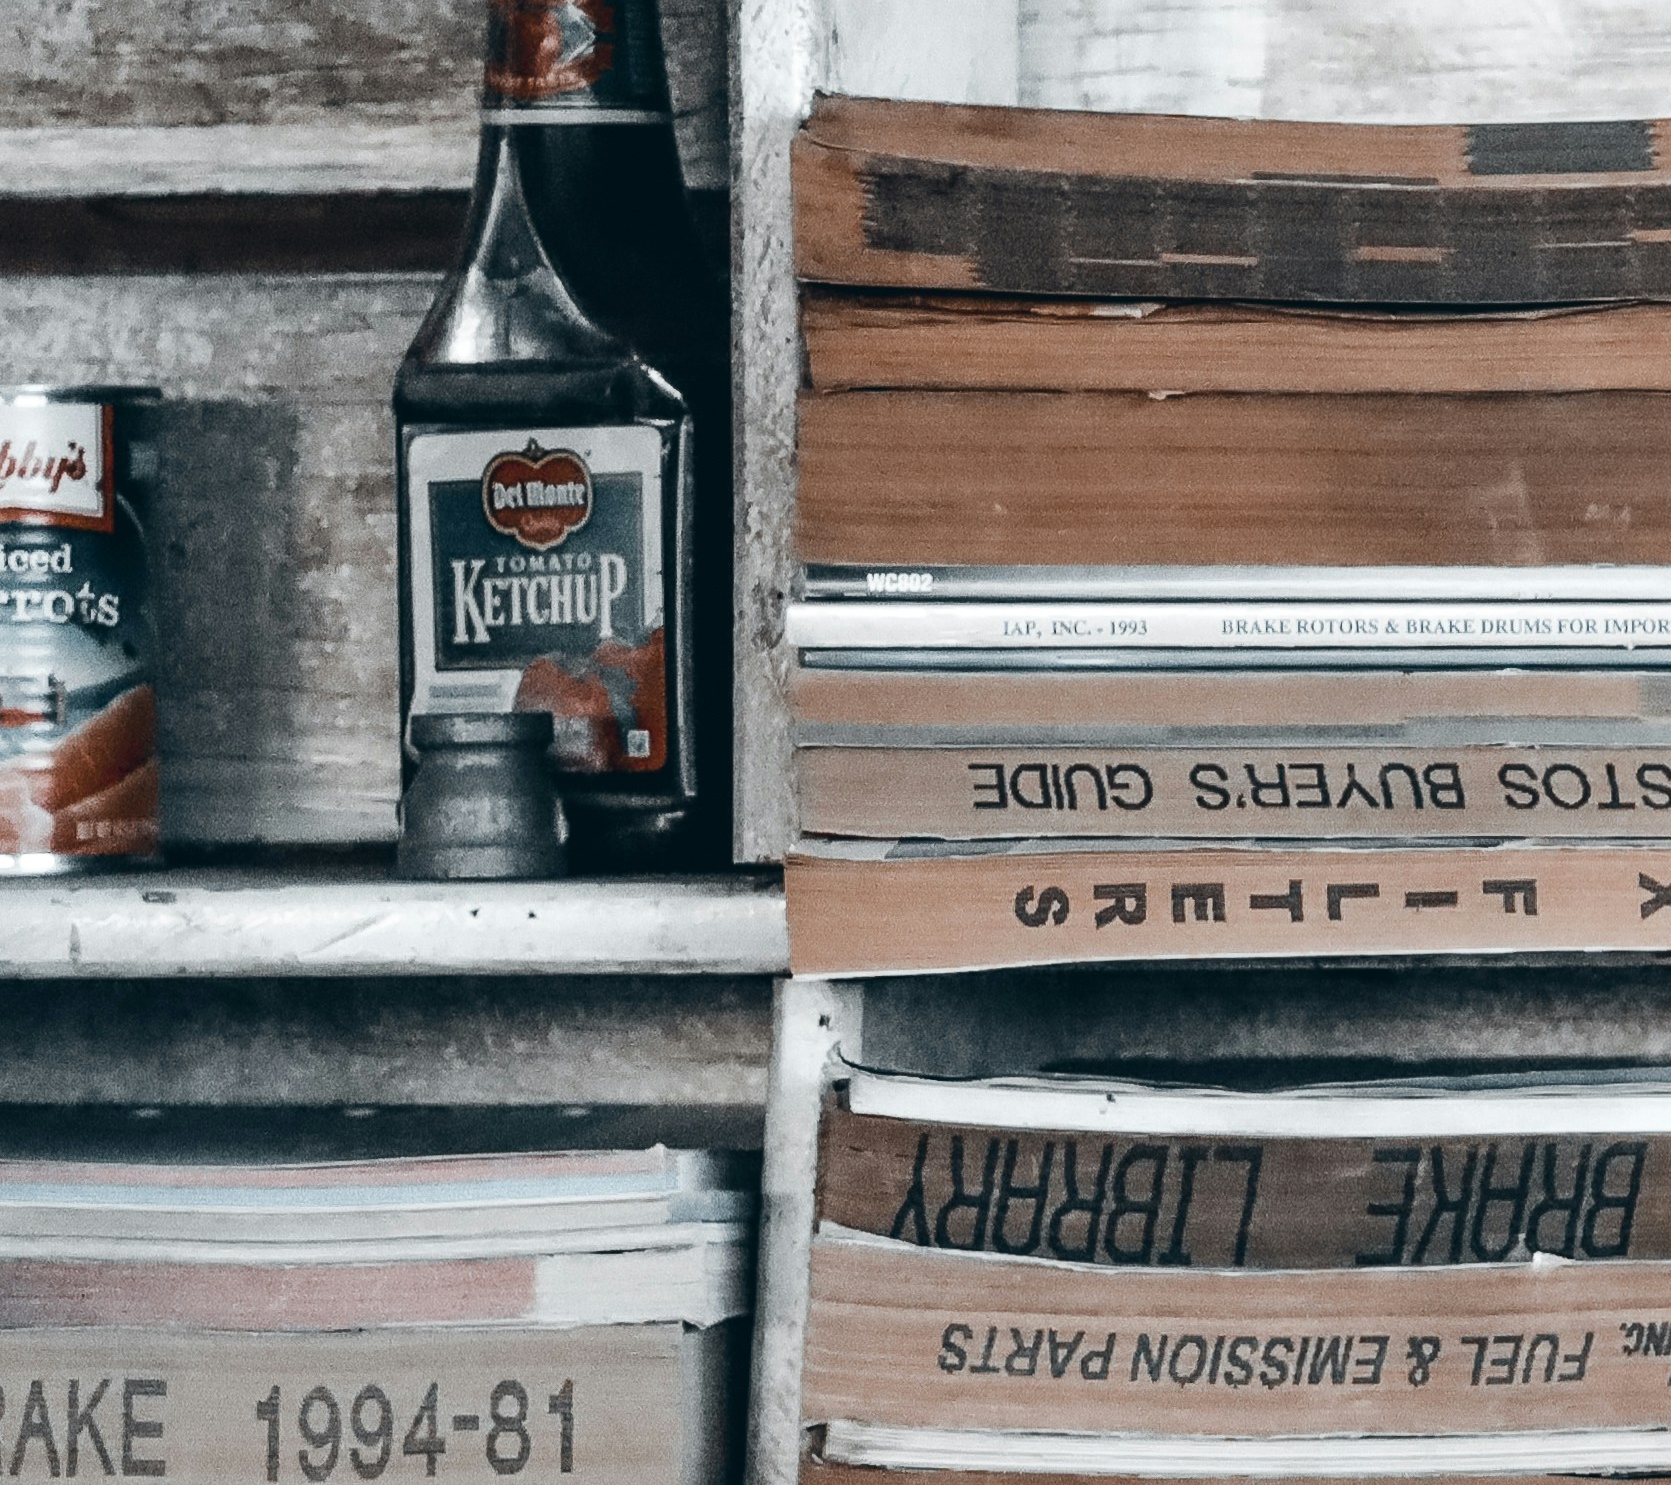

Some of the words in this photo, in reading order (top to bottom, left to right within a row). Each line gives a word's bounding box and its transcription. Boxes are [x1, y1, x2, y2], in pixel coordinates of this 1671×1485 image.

[492, 481, 523, 509] Del
[526, 480, 586, 507] Monte
[497, 554, 593, 573] TOMATO
[450, 552, 629, 645] KETCHUP
[1219, 619, 1289, 637] BRAKE
[1294, 618, 1377, 637] ROTORS
[1383, 619, 1400, 637] &
[1404, 618, 1472, 636] BRAKE
[1479, 618, 1551, 636] DRUMS
[1556, 618, 1599, 636] FOR
[966, 762, 1155, 812] GUIDE
[1188, 761, 1467, 812] BUYER'S
[1013, 875, 1539, 930] FILTERS
[887, 1131, 1265, 1261] LIBRARY
[1356, 1141, 1647, 1265] BRAKE
[936, 1321, 1119, 1383] PARTS
[1129, 1332, 1392, 1391] EMISSION
[1404, 1333, 1444, 1390] &
[1458, 1330, 1597, 1388] FUEL
[0, 1376, 168, 1480] AKE
[254, 1378, 576, 1484] 1994-81
